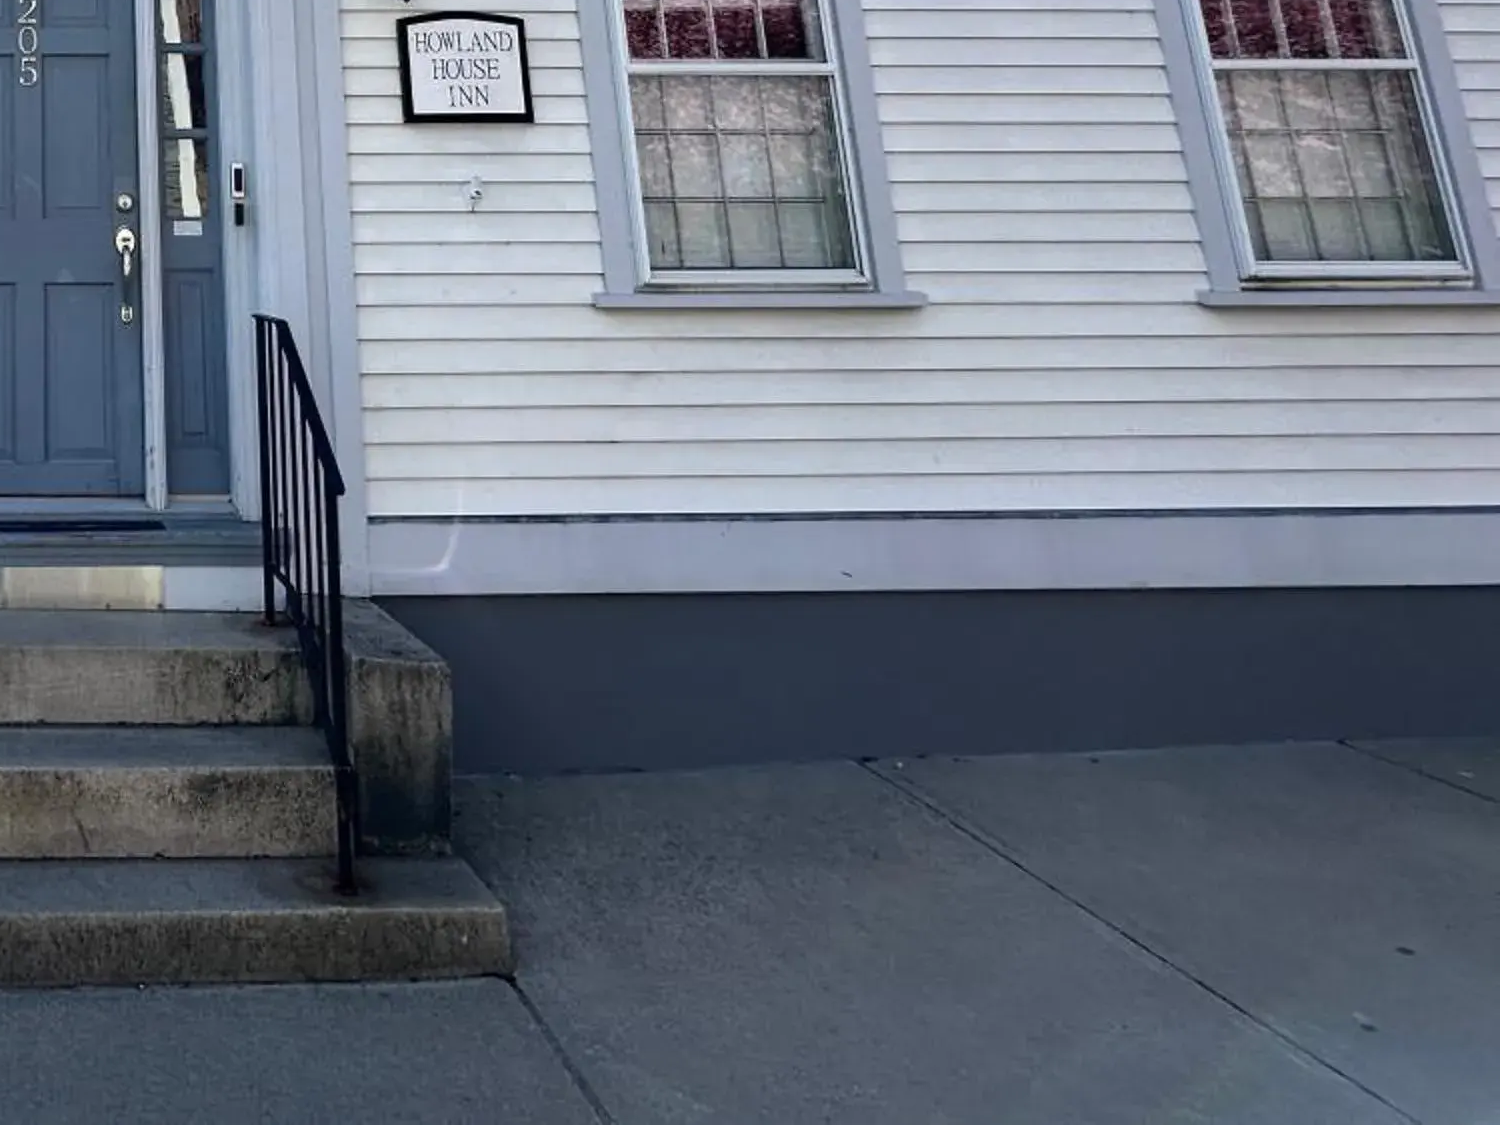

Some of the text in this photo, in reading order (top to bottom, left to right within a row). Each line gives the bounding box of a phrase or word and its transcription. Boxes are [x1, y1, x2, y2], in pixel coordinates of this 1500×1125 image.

[414, 30, 513, 53] HOWLAND
[431, 58, 501, 80] HOUSE
[448, 84, 489, 107] INN
